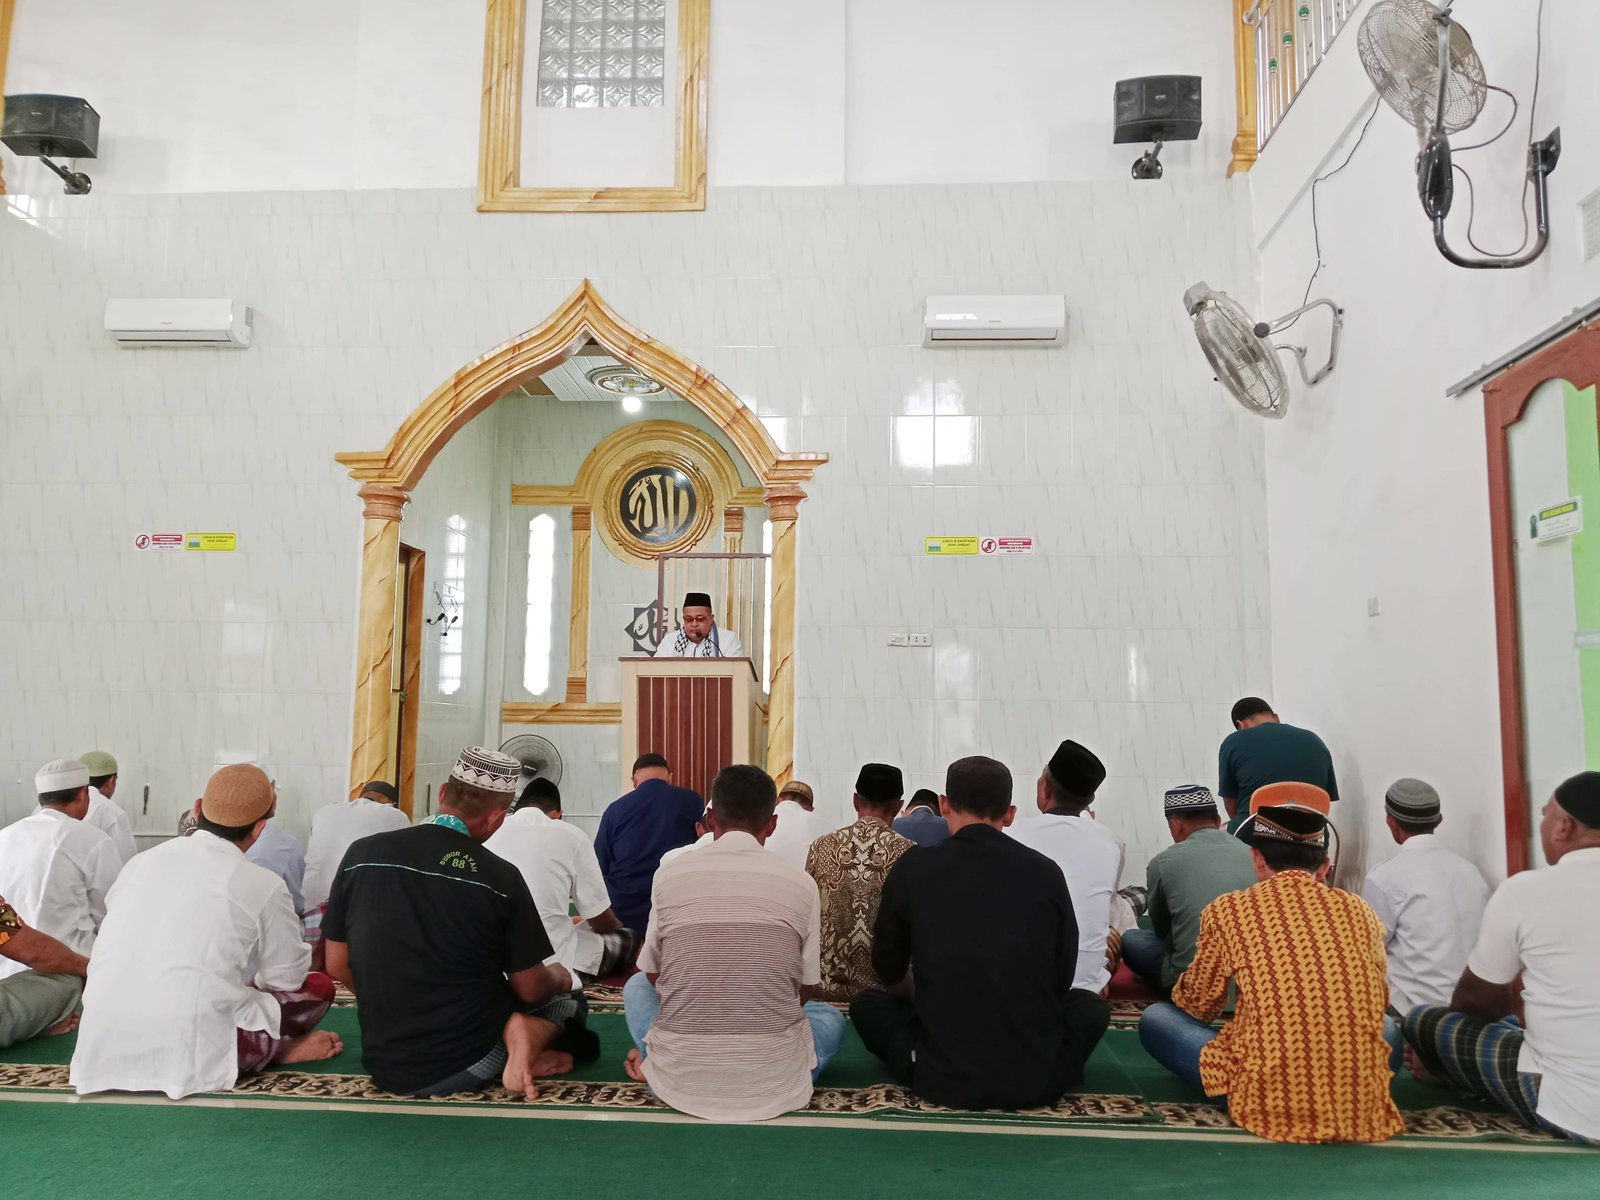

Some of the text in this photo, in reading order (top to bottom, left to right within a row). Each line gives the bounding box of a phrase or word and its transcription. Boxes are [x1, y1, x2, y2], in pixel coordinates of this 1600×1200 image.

[440, 851, 477, 872] BUBUR AYAM
[452, 858, 466, 869] 88
